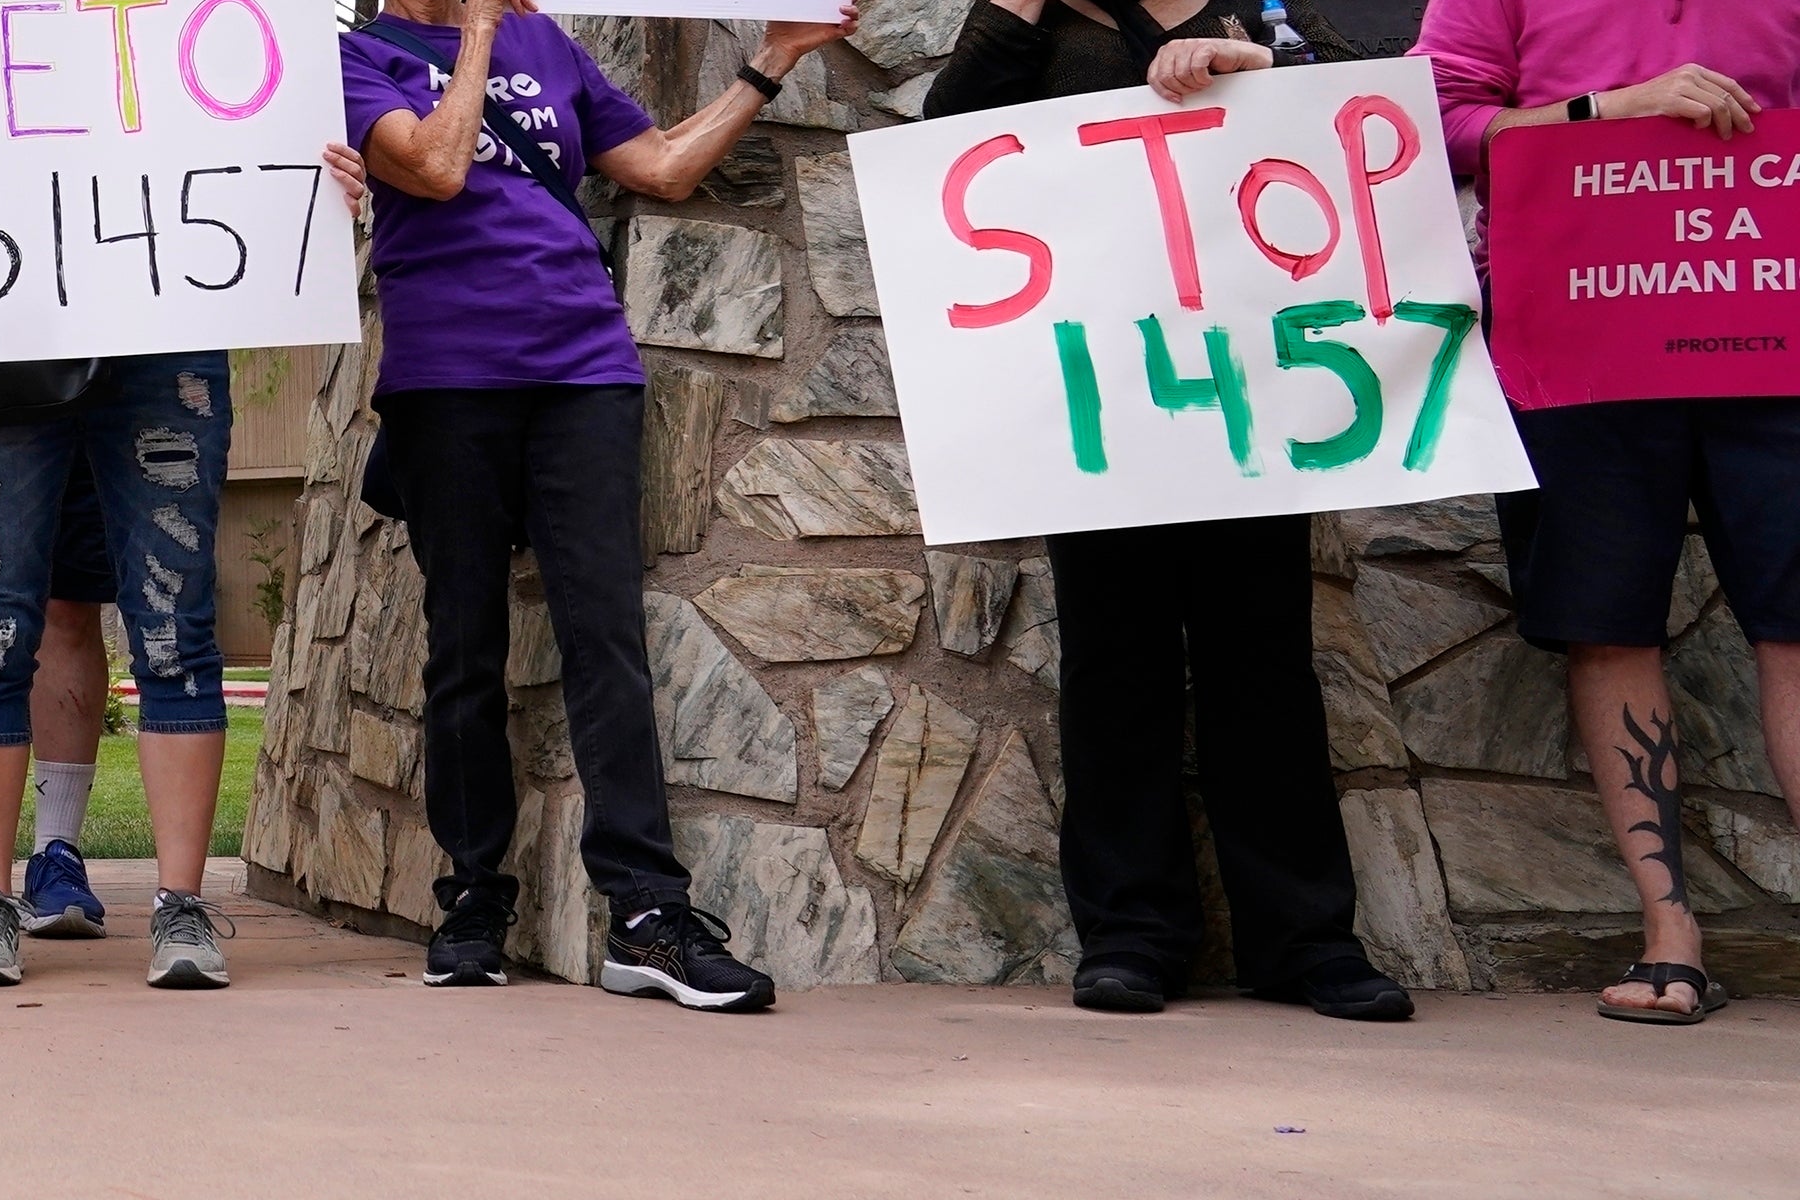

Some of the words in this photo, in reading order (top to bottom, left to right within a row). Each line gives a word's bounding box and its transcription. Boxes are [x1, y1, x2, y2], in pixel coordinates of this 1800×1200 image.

[1573, 156, 1735, 197] HEALTH
[942, 93, 1422, 329] STOP
[1675, 208, 1714, 242] IS
[1725, 207, 1763, 241] A
[1569, 259, 1737, 300] HUMAN
[1753, 258, 1800, 292] RI
[1664, 336, 1788, 354] #PROTECTX
[1053, 300, 1480, 478] 1457
